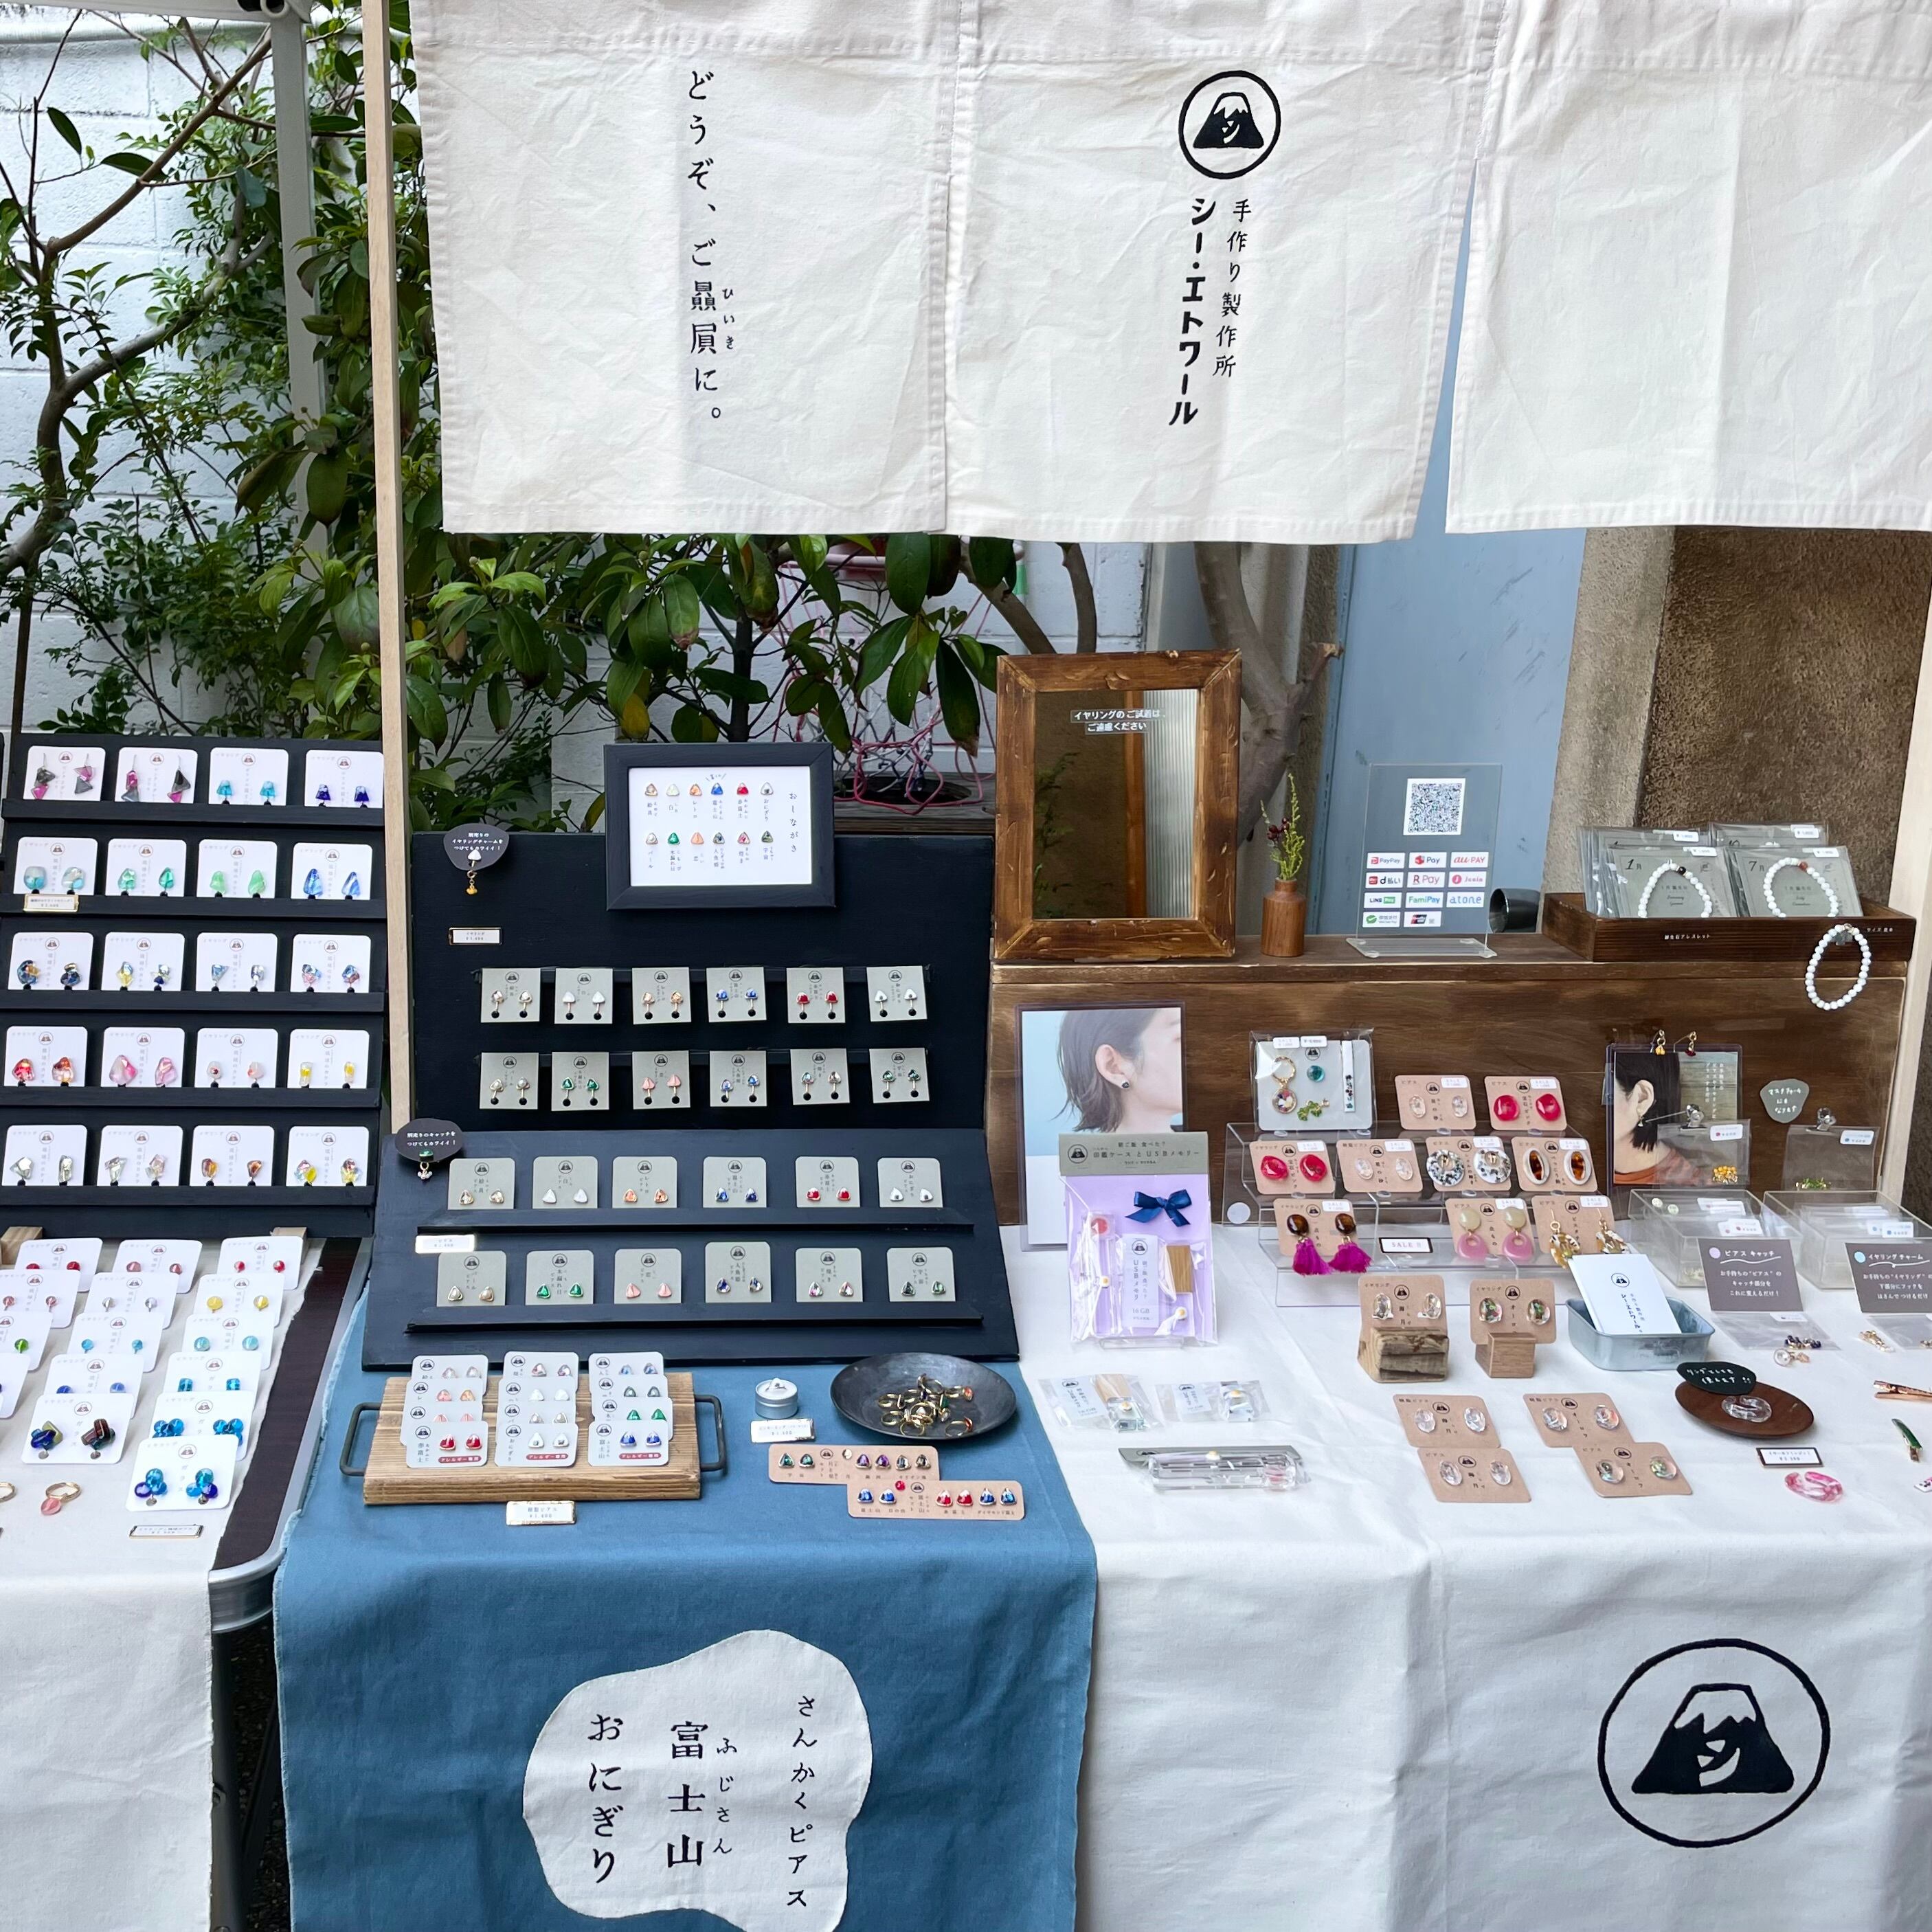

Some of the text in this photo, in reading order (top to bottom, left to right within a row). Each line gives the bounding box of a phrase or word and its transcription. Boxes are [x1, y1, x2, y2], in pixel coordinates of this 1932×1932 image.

[723, 287, 735, 350] ひいき
[1169, 198, 1216, 425] シー・エトワール
[1213, 199, 1251, 377] 手作り製作所
[789, 792, 798, 853] おしながき
[1422, 875, 1440, 885] Pay
[1450, 895, 1482, 904] atone
[587, 1714, 624, 1884] おにぎり
[666, 1720, 708, 1868] 富士山
[712, 1738, 738, 1854] ふじさん
[787, 1695, 818, 1907] さんかくピアス
